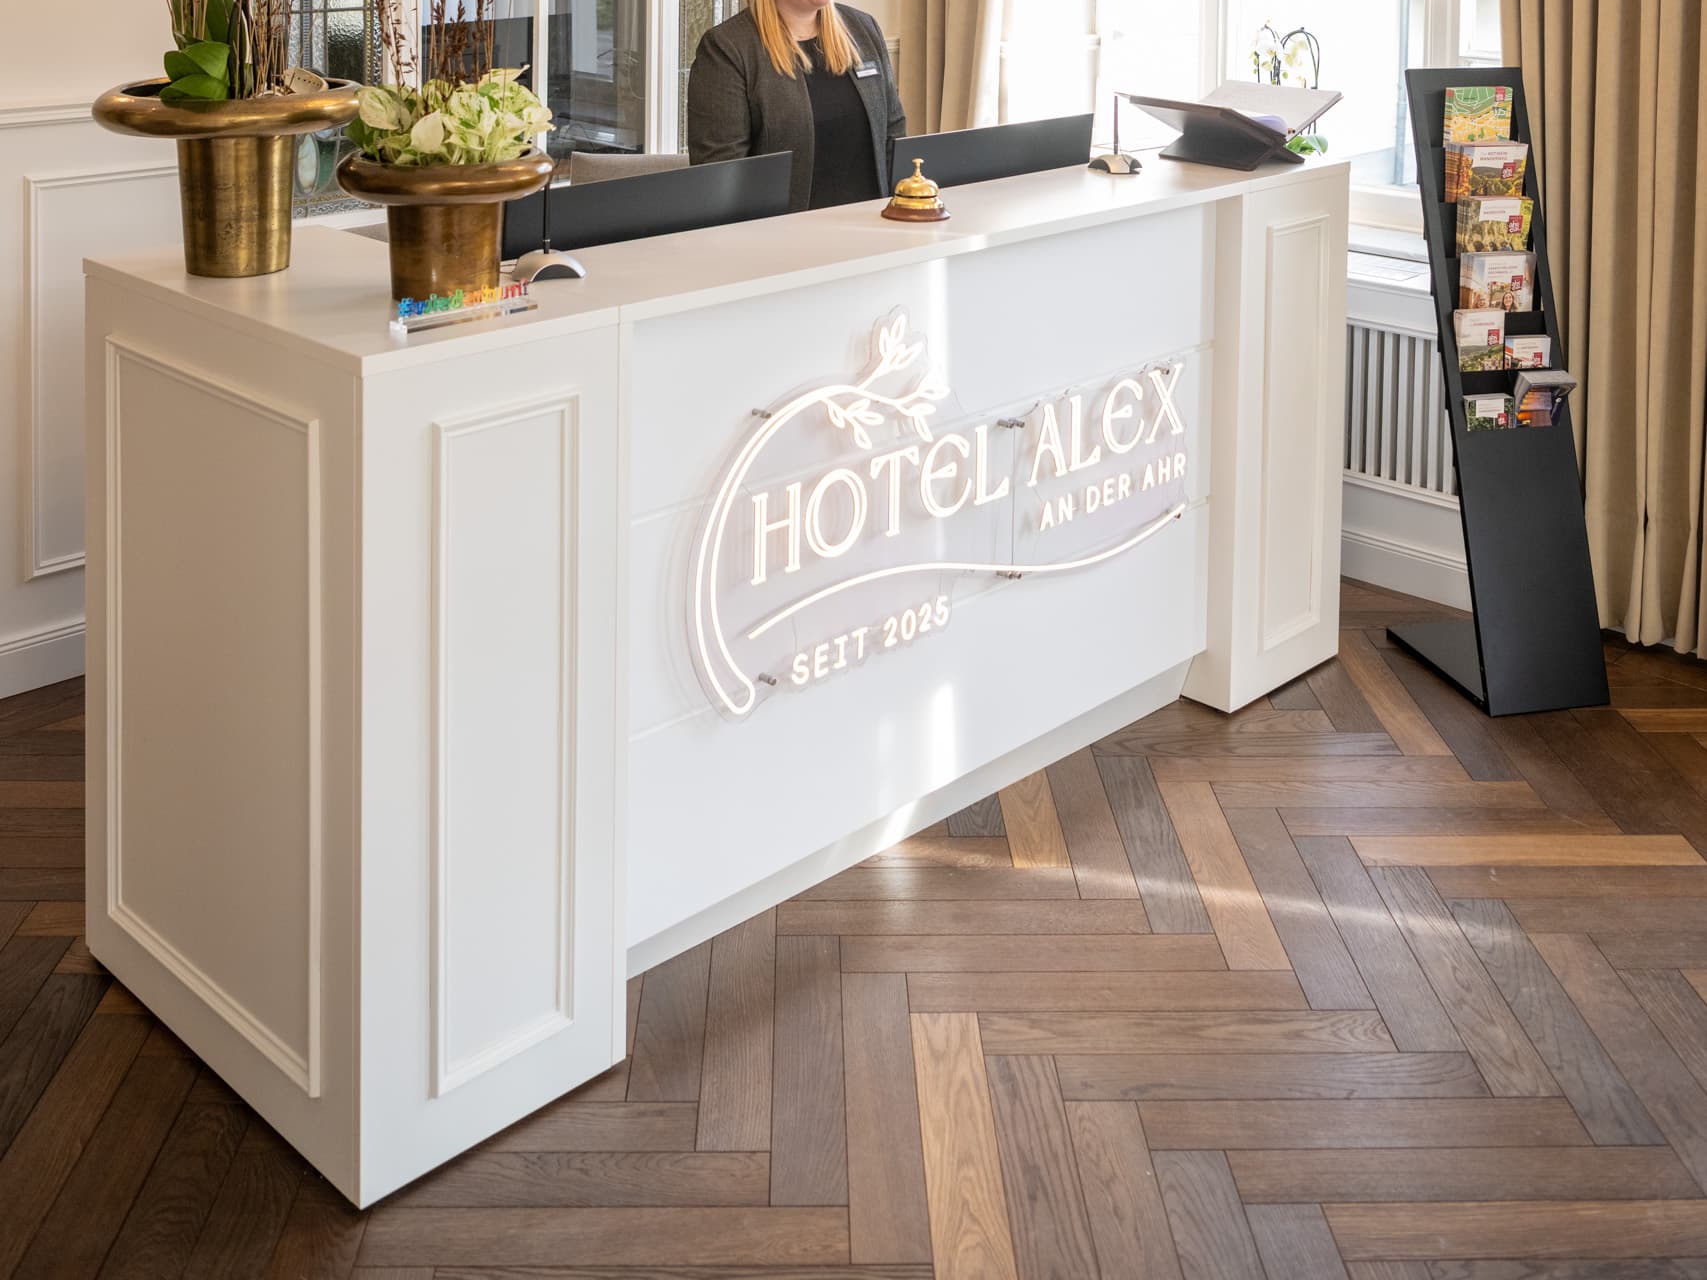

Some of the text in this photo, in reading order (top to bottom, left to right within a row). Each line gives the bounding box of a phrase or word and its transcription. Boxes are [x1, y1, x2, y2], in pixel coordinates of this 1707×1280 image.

[751, 362, 1184, 585] HOTEL ALEX
[1039, 452, 1186, 532] AN DER AHR
[791, 596, 950, 686] SEIT 2025
